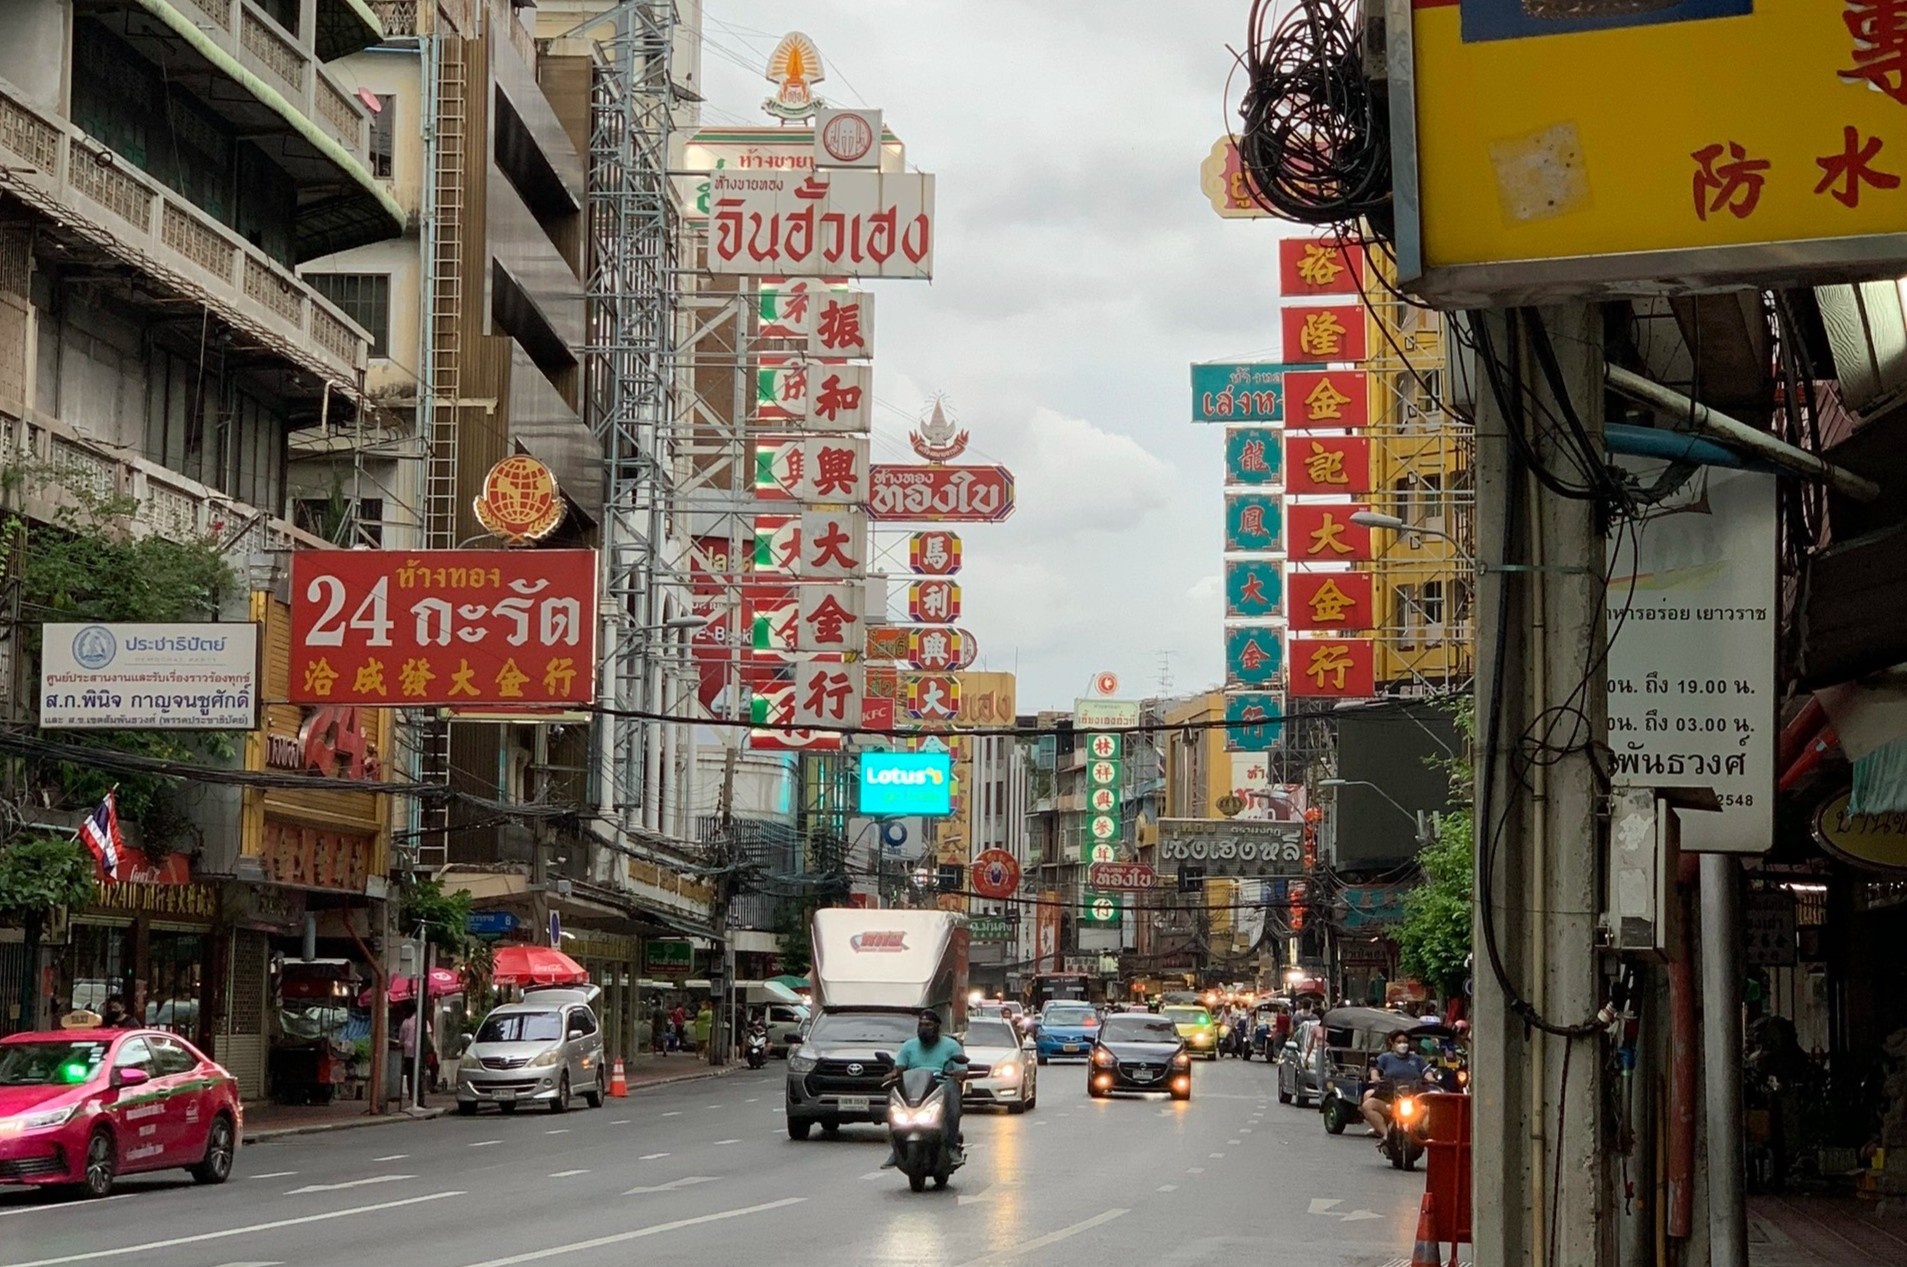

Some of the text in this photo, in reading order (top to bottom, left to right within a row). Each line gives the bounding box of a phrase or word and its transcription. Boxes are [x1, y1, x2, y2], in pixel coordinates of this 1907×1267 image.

[714, 174, 784, 191] ห้างขายทอง
[1690, 125, 1901, 222] 防水
[1202, 384, 1284, 417] เล่งห
[871, 470, 1000, 514] ทองใบ
[804, 299, 866, 721] 振和興大金行
[396, 559, 501, 588] ห้างทอง
[304, 574, 581, 648] 24 กะรัต
[125, 636, 228, 653] ประชาธิปัตย์
[1677, 679, 1727, 694] 19.00
[1734, 679, 1755, 694] น.
[862, 707, 888, 722] KFC
[1676, 717, 1727, 732] 03.00
[1734, 718, 1755, 732] น.
[504, 915, 512, 926] 8
